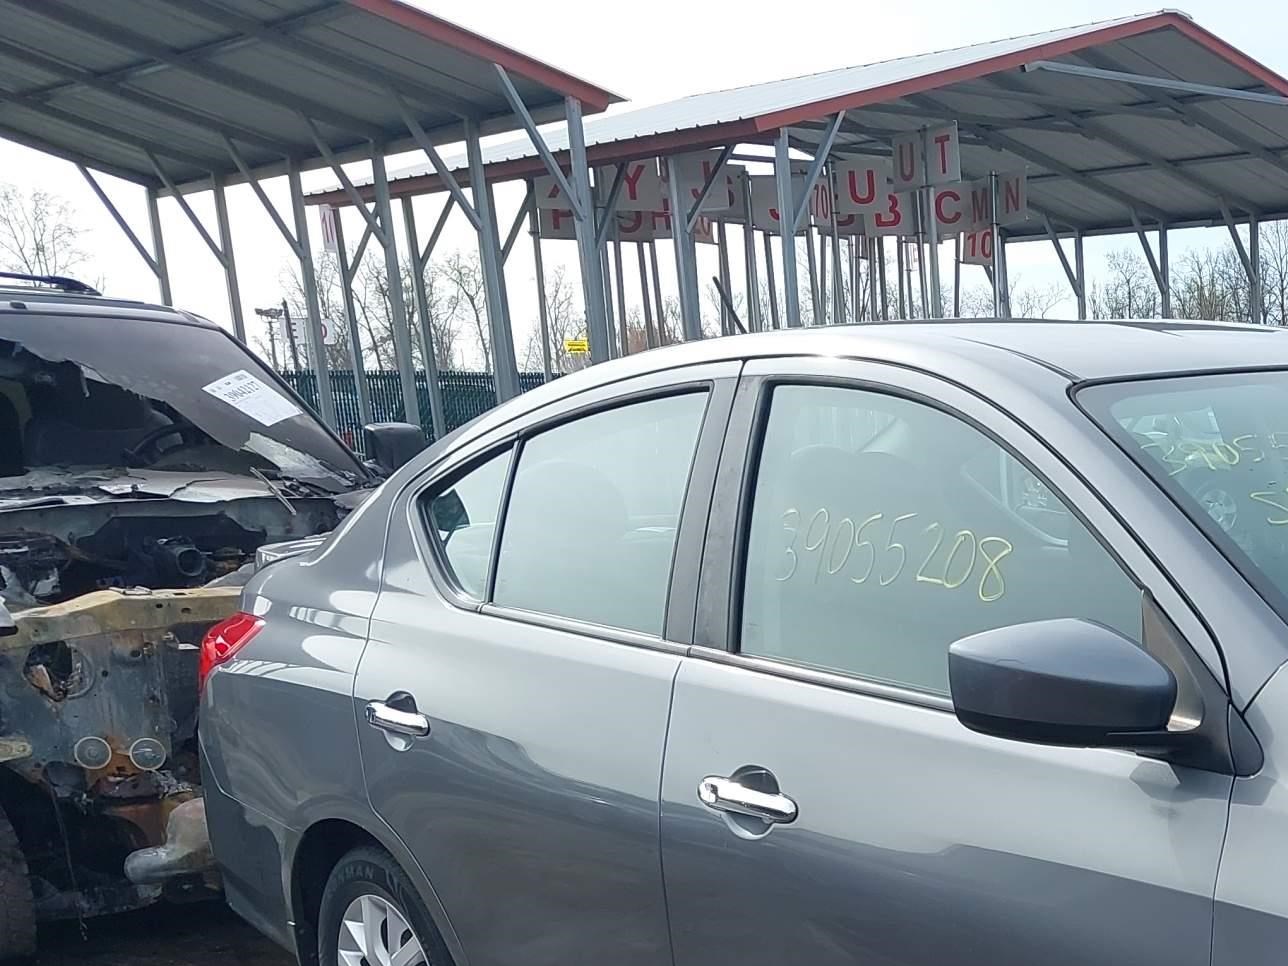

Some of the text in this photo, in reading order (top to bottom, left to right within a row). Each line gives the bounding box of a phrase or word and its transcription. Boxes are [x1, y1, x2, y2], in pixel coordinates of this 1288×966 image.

[899, 143, 914, 181] U
[934, 135, 950, 174] T
[622, 164, 645, 200] Y
[848, 169, 876, 204] U
[1004, 177, 1020, 214] N
[935, 190, 962, 224] C
[971, 187, 989, 223] M
[967, 231, 992, 259] 10
[776, 508, 1014, 602] 39055208
